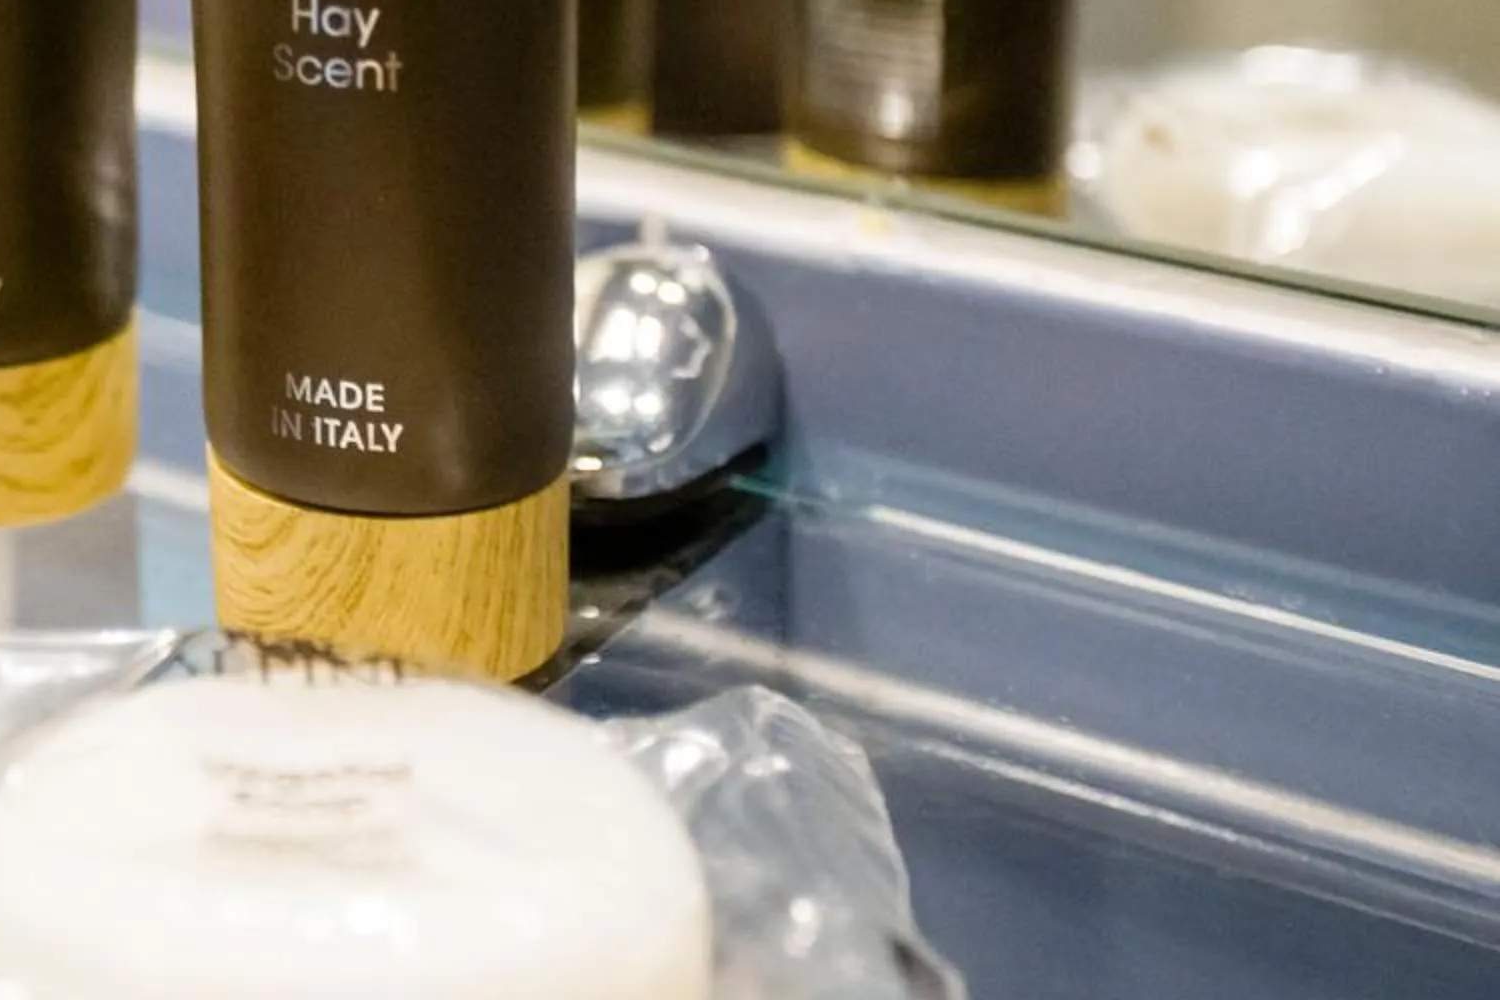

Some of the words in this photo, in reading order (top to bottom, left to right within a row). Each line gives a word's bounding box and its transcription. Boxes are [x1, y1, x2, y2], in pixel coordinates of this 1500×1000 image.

[272, 43, 404, 93] Scent
[285, 371, 386, 413] MADE
[270, 404, 302, 441] IN
[313, 415, 404, 453] ITALY
